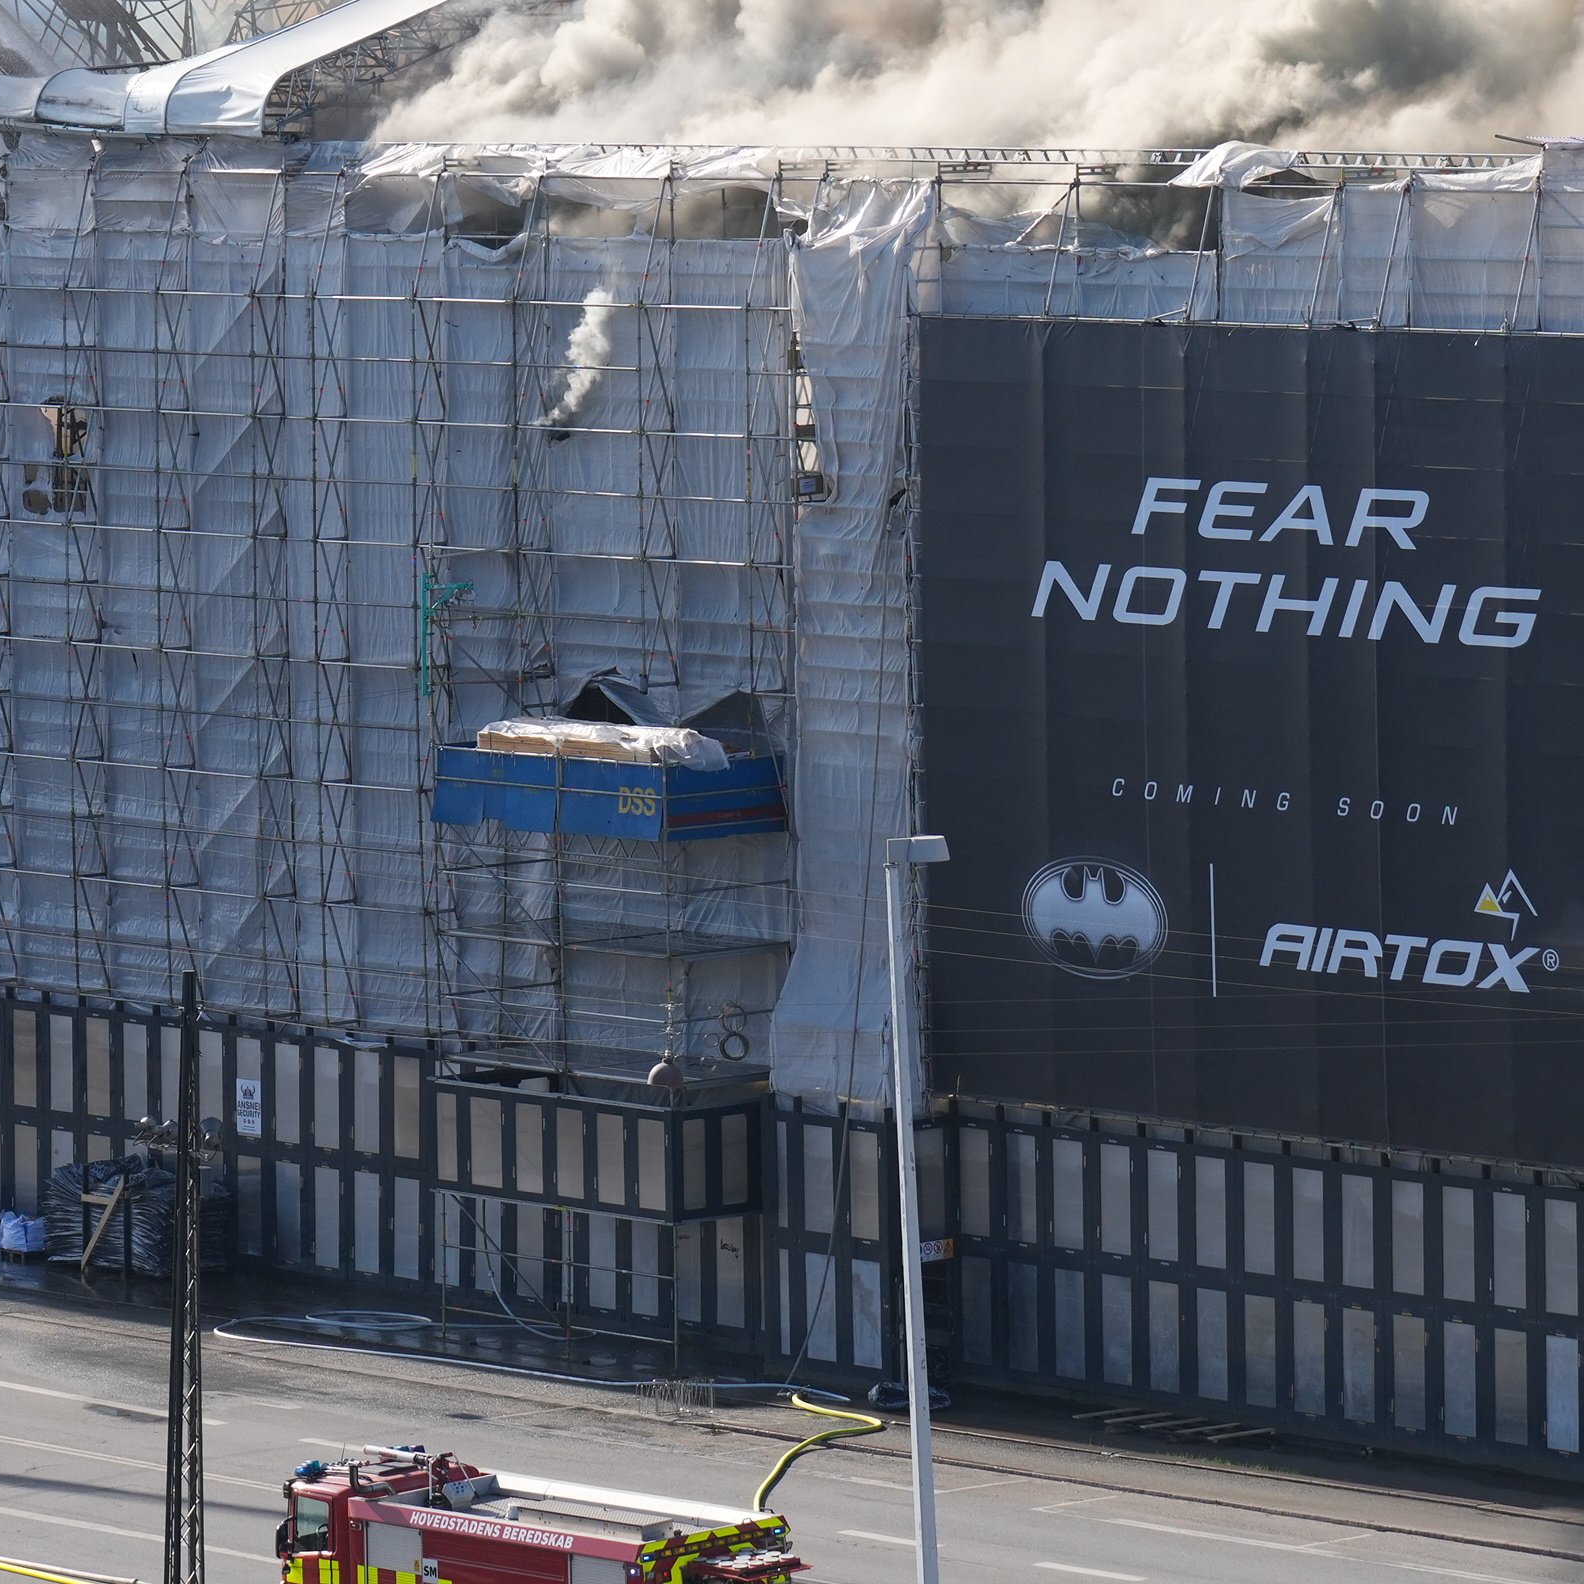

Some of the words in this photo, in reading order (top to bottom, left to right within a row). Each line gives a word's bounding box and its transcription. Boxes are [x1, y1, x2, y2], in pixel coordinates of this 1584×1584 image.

[1131, 476, 1430, 551] FEAR
[1030, 559, 1543, 649] NOTHING
[618, 785, 657, 816] DSS
[1112, 777, 1292, 813] COMING
[1337, 796, 1459, 827] SOON
[237, 1108, 261, 1119] SECURITY
[410, 1511, 501, 1538] HOVEDSTADENS
[502, 1526, 574, 1549] BEREDSKAB
[423, 1565, 437, 1578] SM
